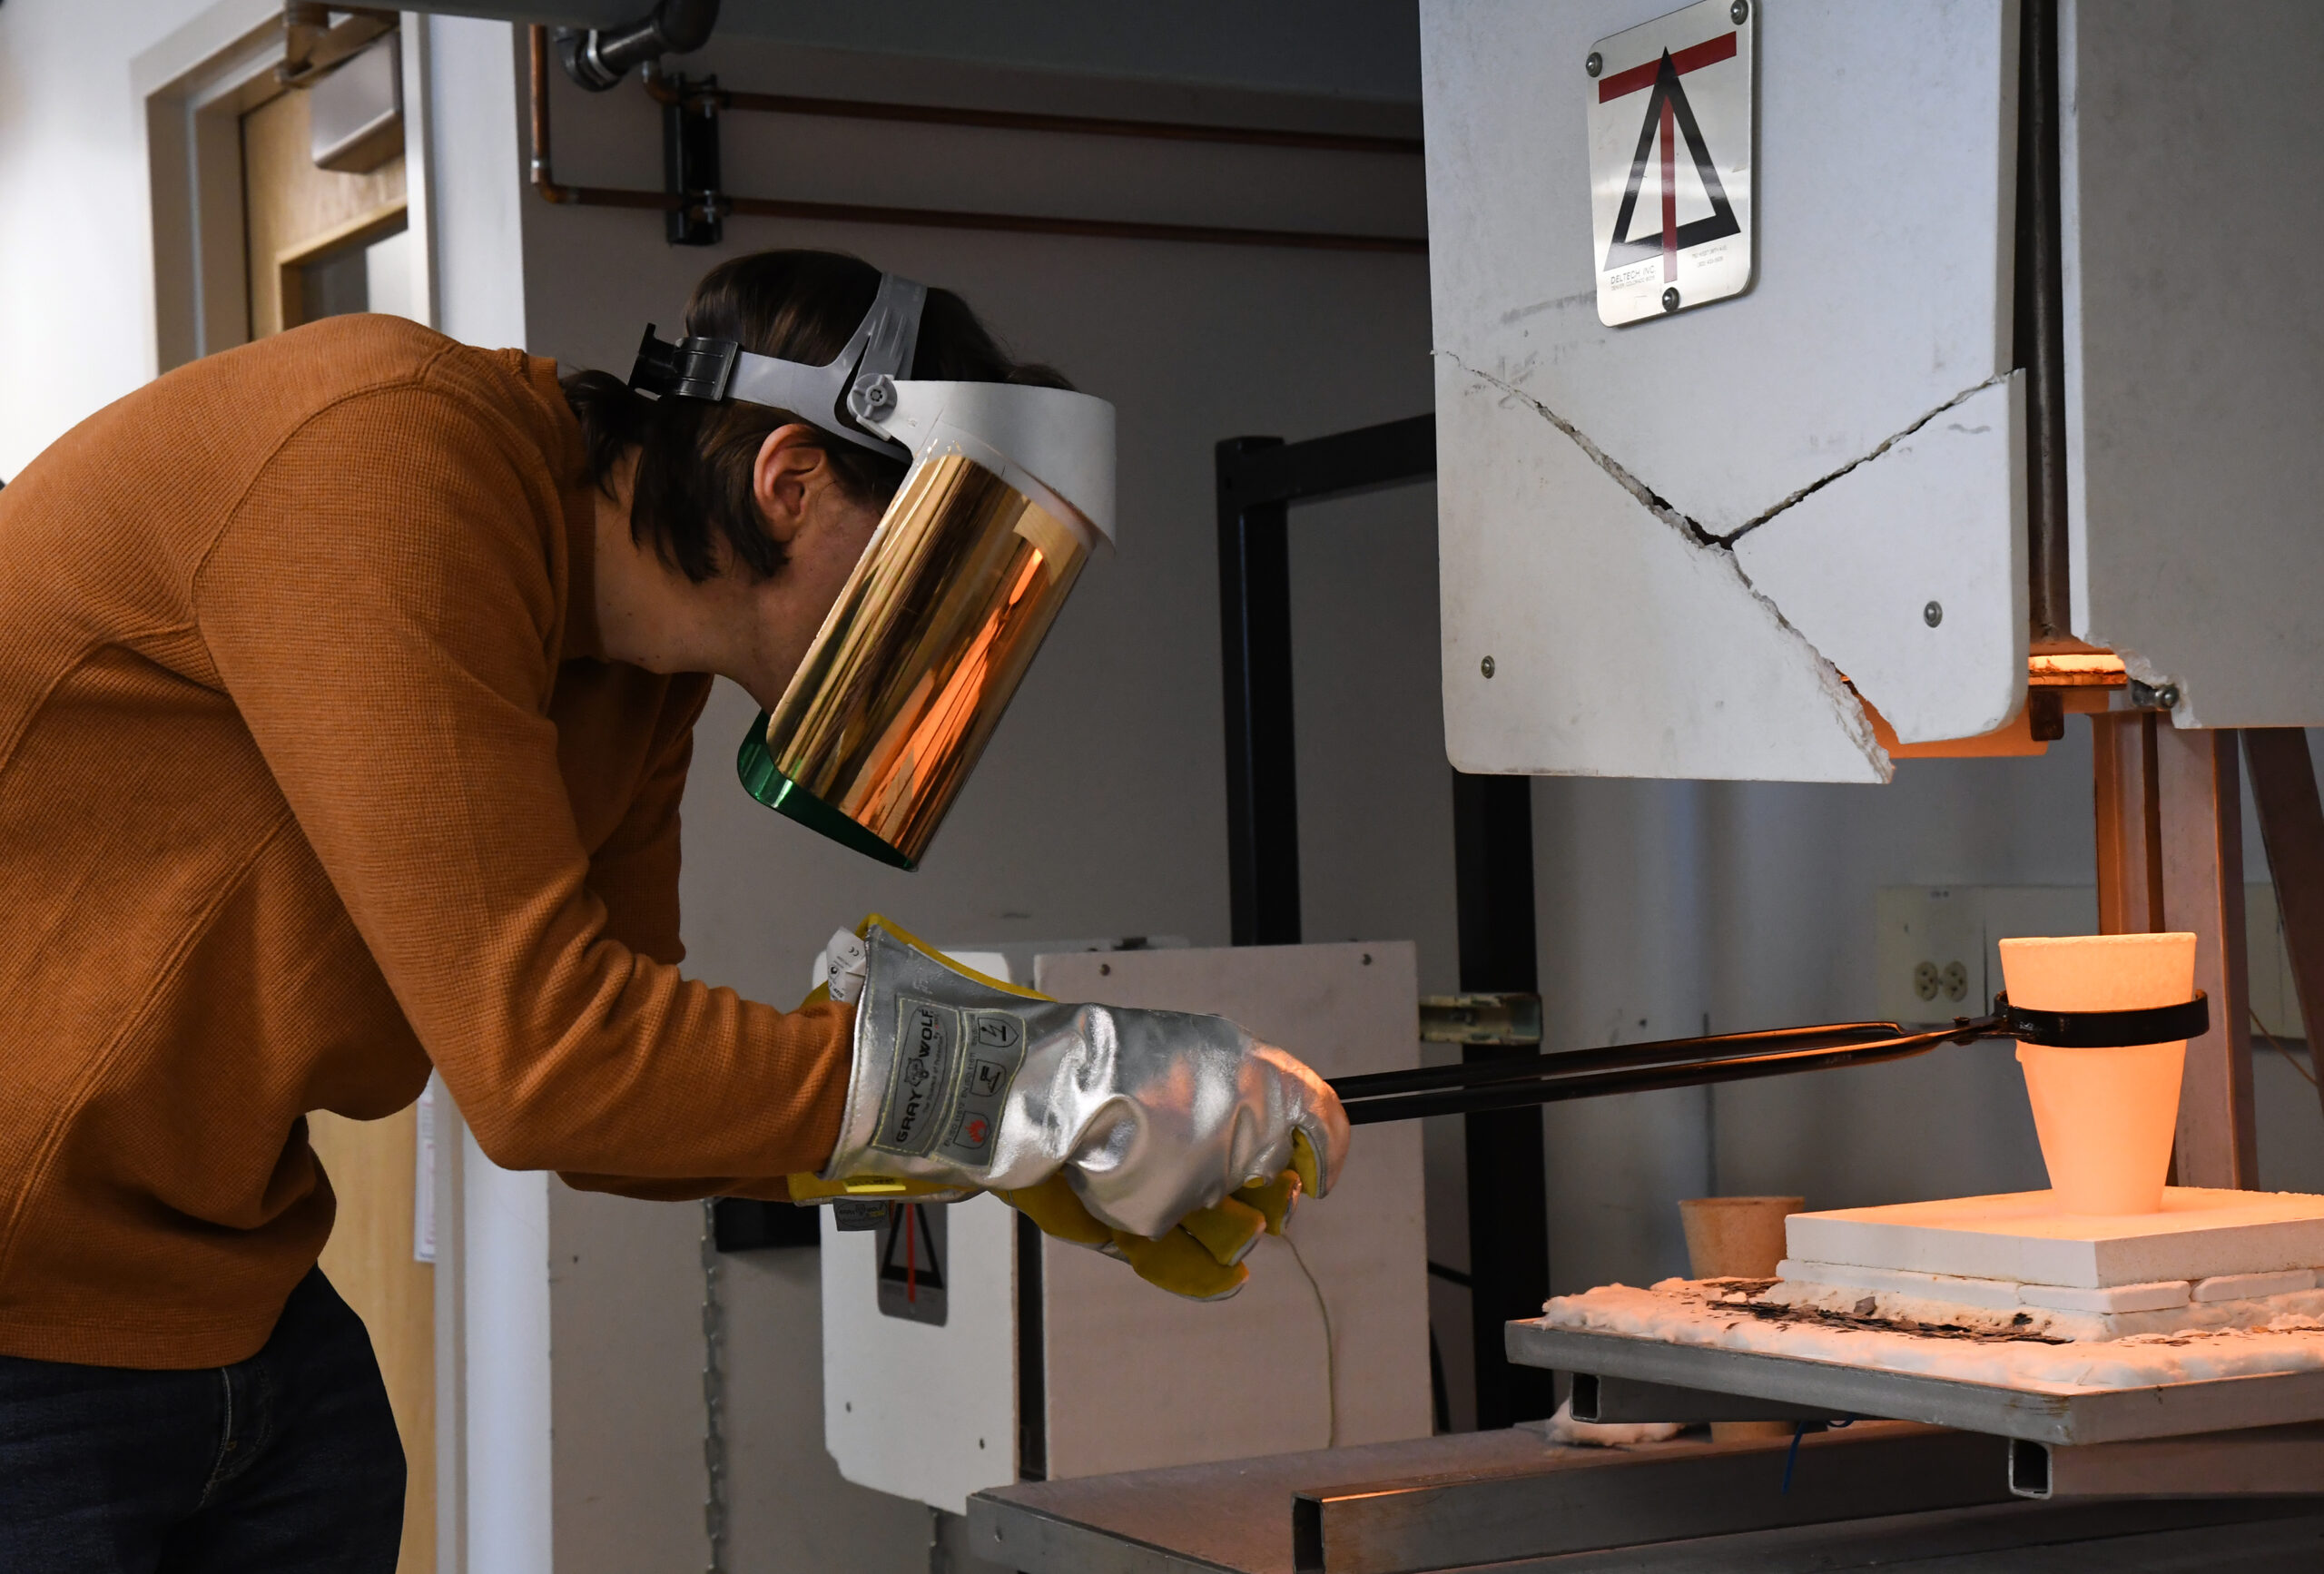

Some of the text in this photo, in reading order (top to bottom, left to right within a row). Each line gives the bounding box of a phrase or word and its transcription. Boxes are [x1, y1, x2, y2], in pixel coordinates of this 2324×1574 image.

[1611, 270, 1640, 284] DELTECH
[895, 1008, 933, 1143] GRAY WOLF
